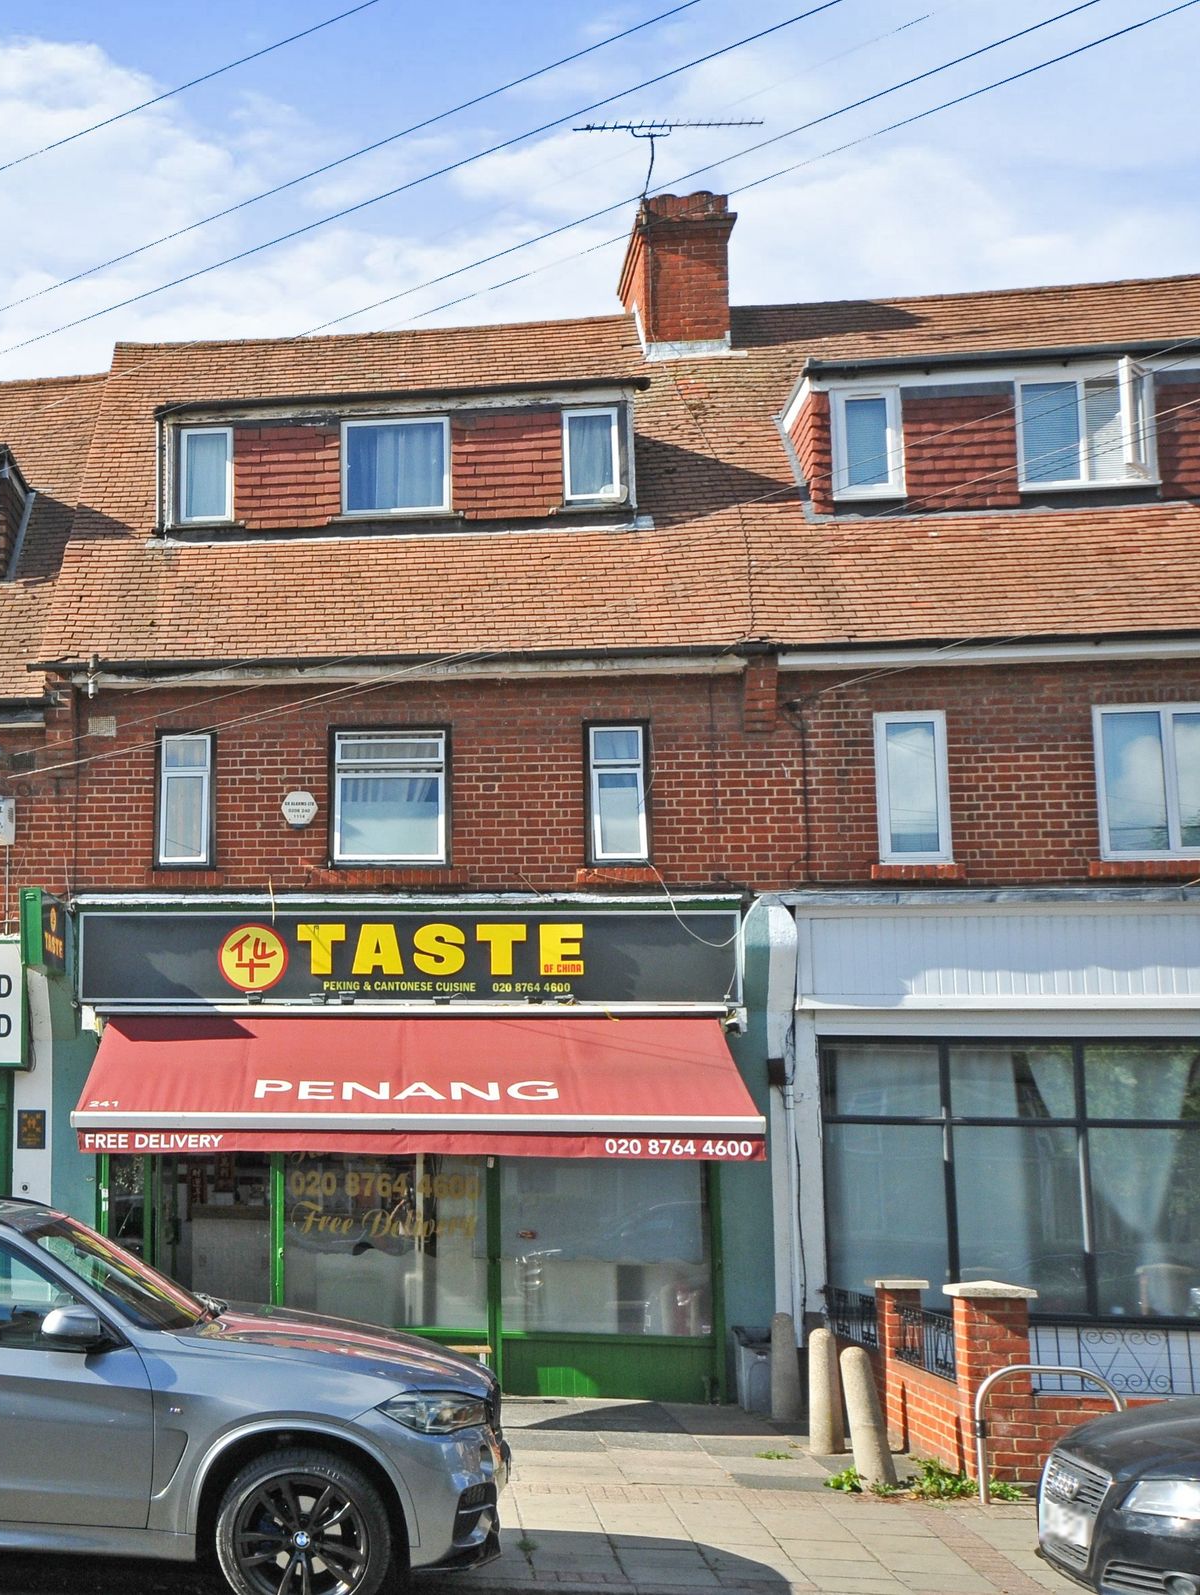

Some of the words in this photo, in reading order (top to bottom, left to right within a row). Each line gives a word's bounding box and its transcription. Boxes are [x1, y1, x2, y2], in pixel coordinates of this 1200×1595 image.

[44, 931, 64, 959] TASTE
[297, 923, 584, 976] TASTE
[543, 964, 553, 973] OF
[556, 964, 582, 973] CHINA
[323, 981, 360, 991] PEKING
[363, 981, 371, 991] &
[373, 981, 433, 992] CANTONESE
[435, 982, 477, 993] CUISINE
[492, 982, 512, 993] 020
[515, 982, 540, 993] 8764
[543, 982, 571, 993] 4600
[253, 1079, 560, 1101] PENANG
[89, 1100, 120, 1108] 241
[84, 1133, 129, 1149] FREE
[135, 1134, 224, 1149] DELIVERY
[604, 1138, 642, 1155] 020
[648, 1139, 697, 1156] 8764
[702, 1140, 753, 1157] 4600
[290, 1170, 337, 1198] 020
[345, 1171, 409, 1199] 8764
[290, 1200, 354, 1235] Free
[361, 1206, 477, 1240] Delivery
